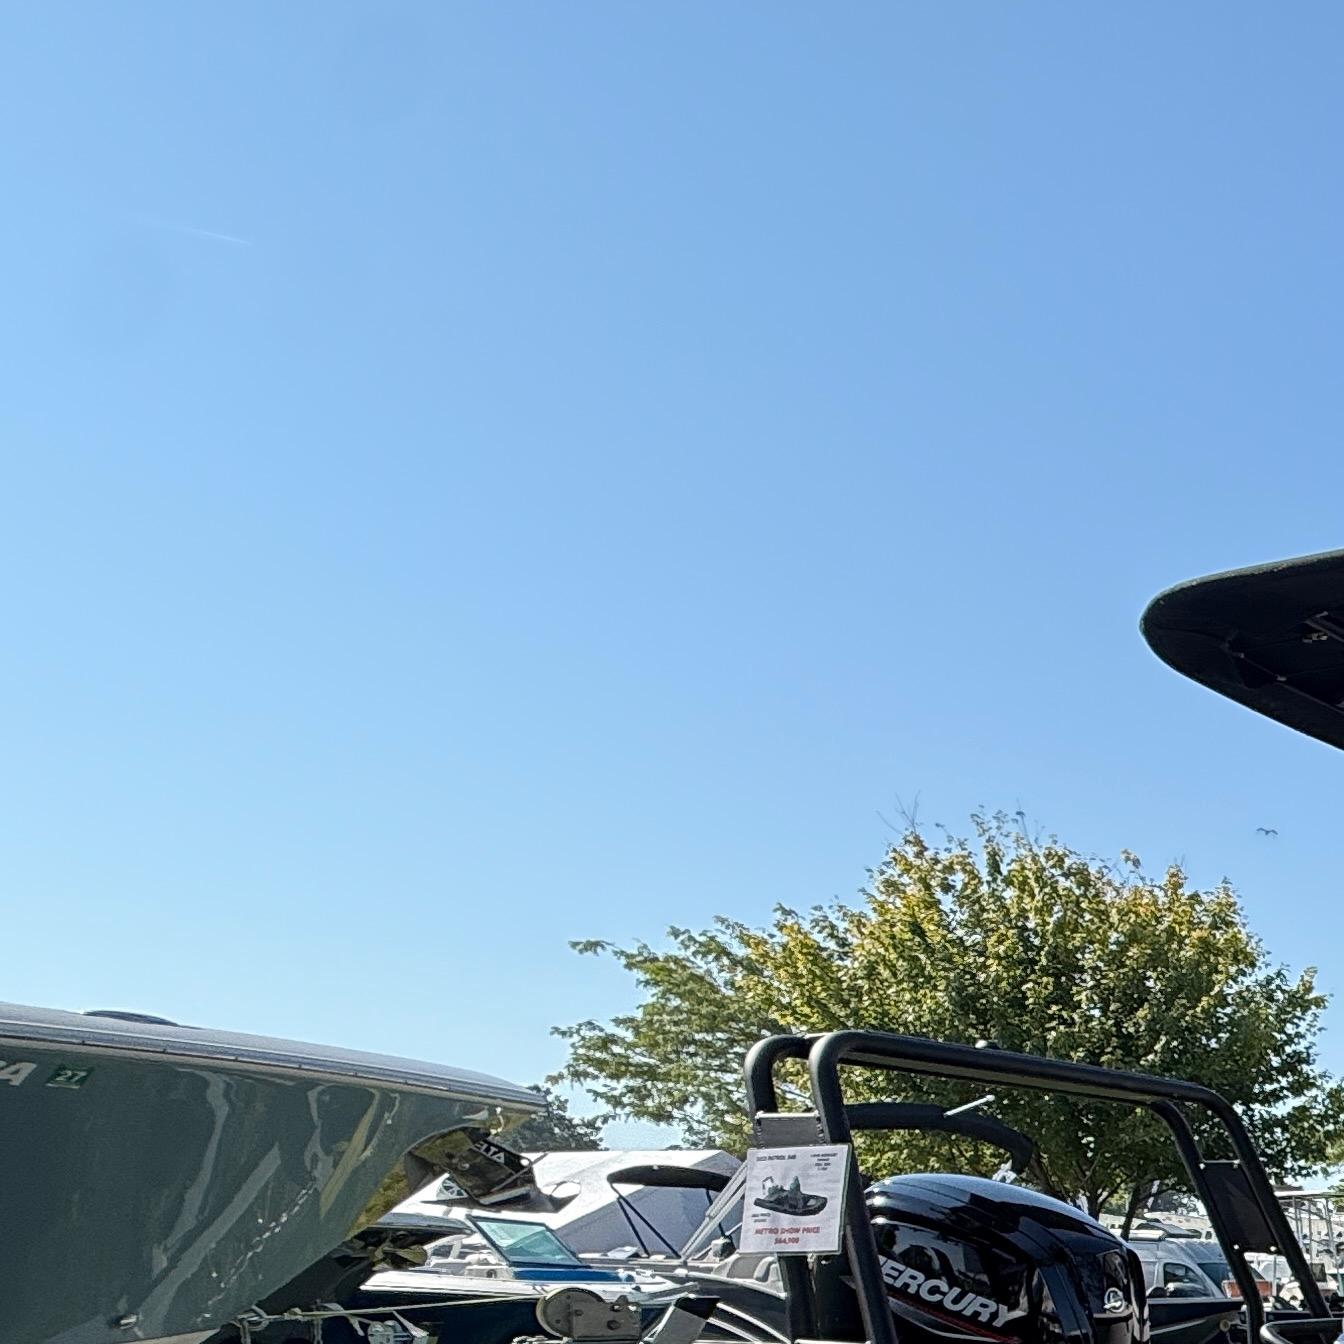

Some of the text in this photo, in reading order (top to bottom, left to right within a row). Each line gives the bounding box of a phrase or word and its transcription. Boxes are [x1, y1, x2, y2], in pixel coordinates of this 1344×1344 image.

[55, 1070, 88, 1082] 27
[755, 1227, 779, 1235] METRO
[802, 1226, 821, 1234] PRICE
